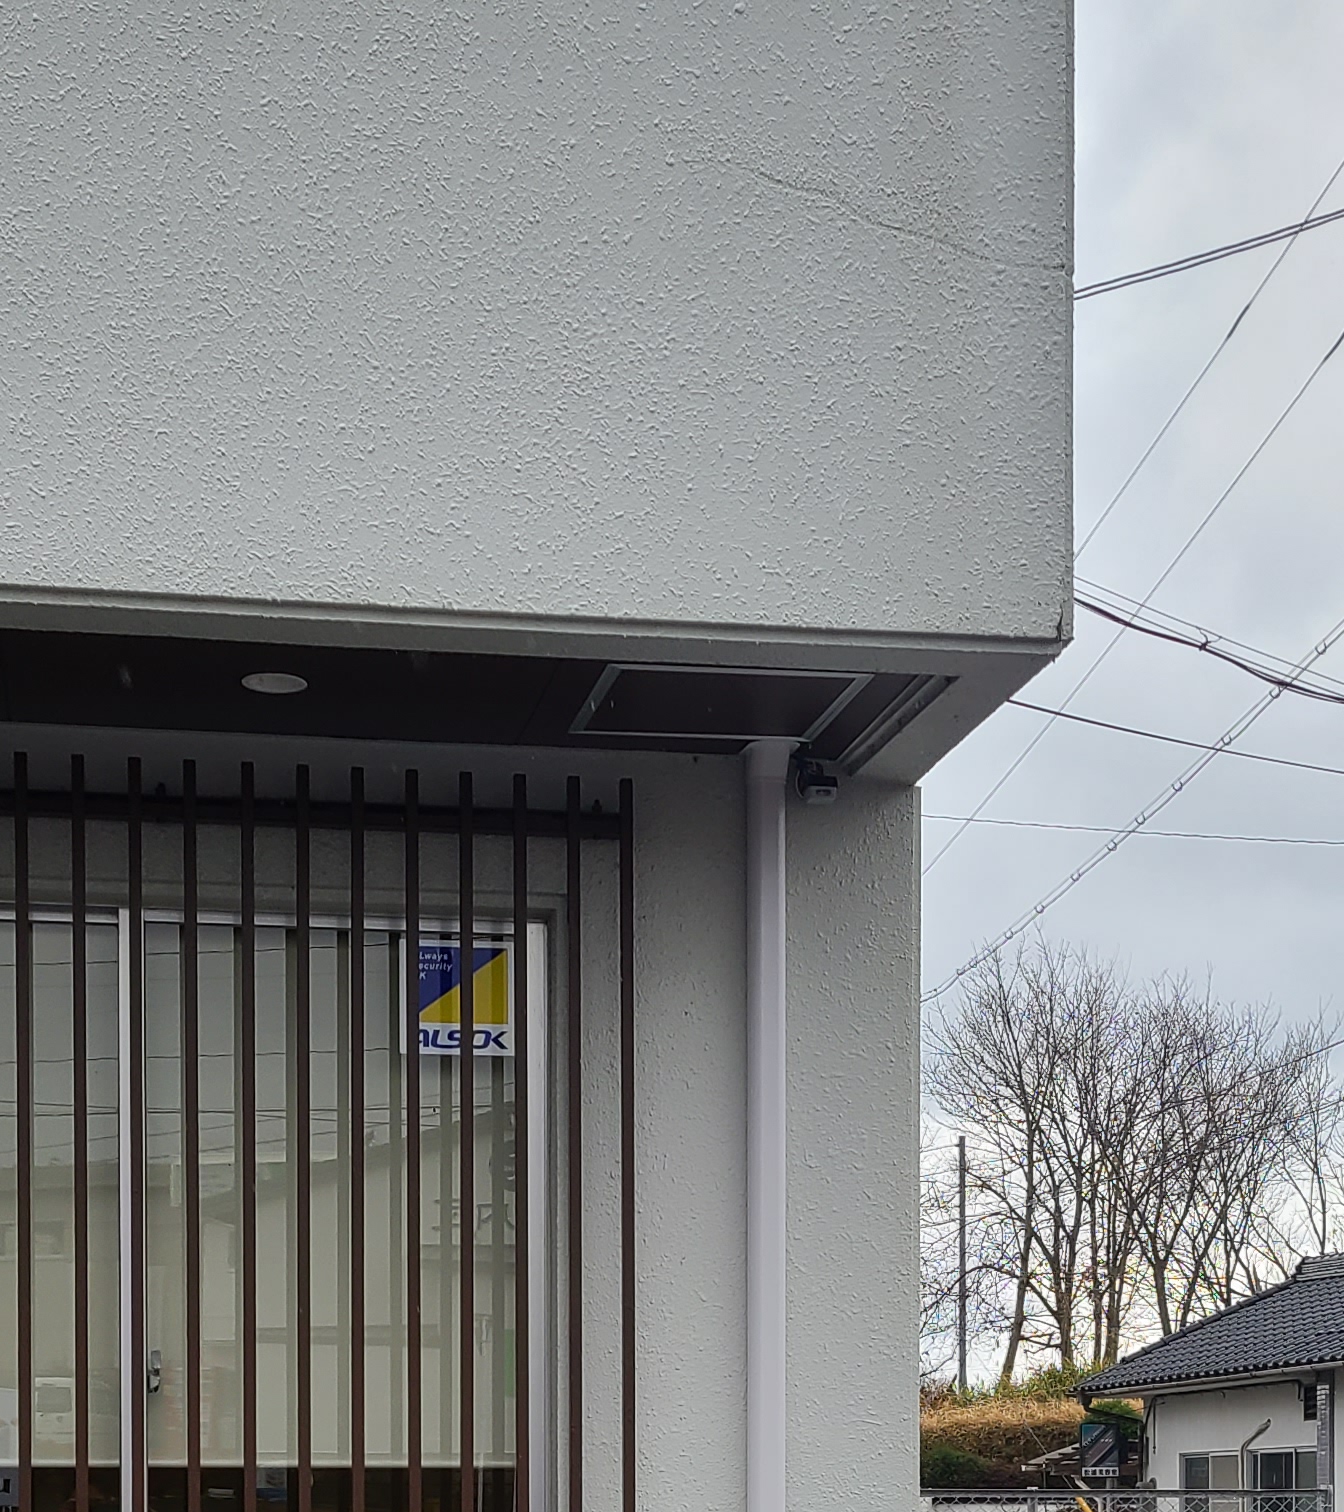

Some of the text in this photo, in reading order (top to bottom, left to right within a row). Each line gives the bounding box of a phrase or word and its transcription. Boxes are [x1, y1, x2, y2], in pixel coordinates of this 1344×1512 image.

[419, 962, 453, 972] ecurity
[419, 971, 427, 980] K
[419, 1029, 509, 1050] ALSOK
